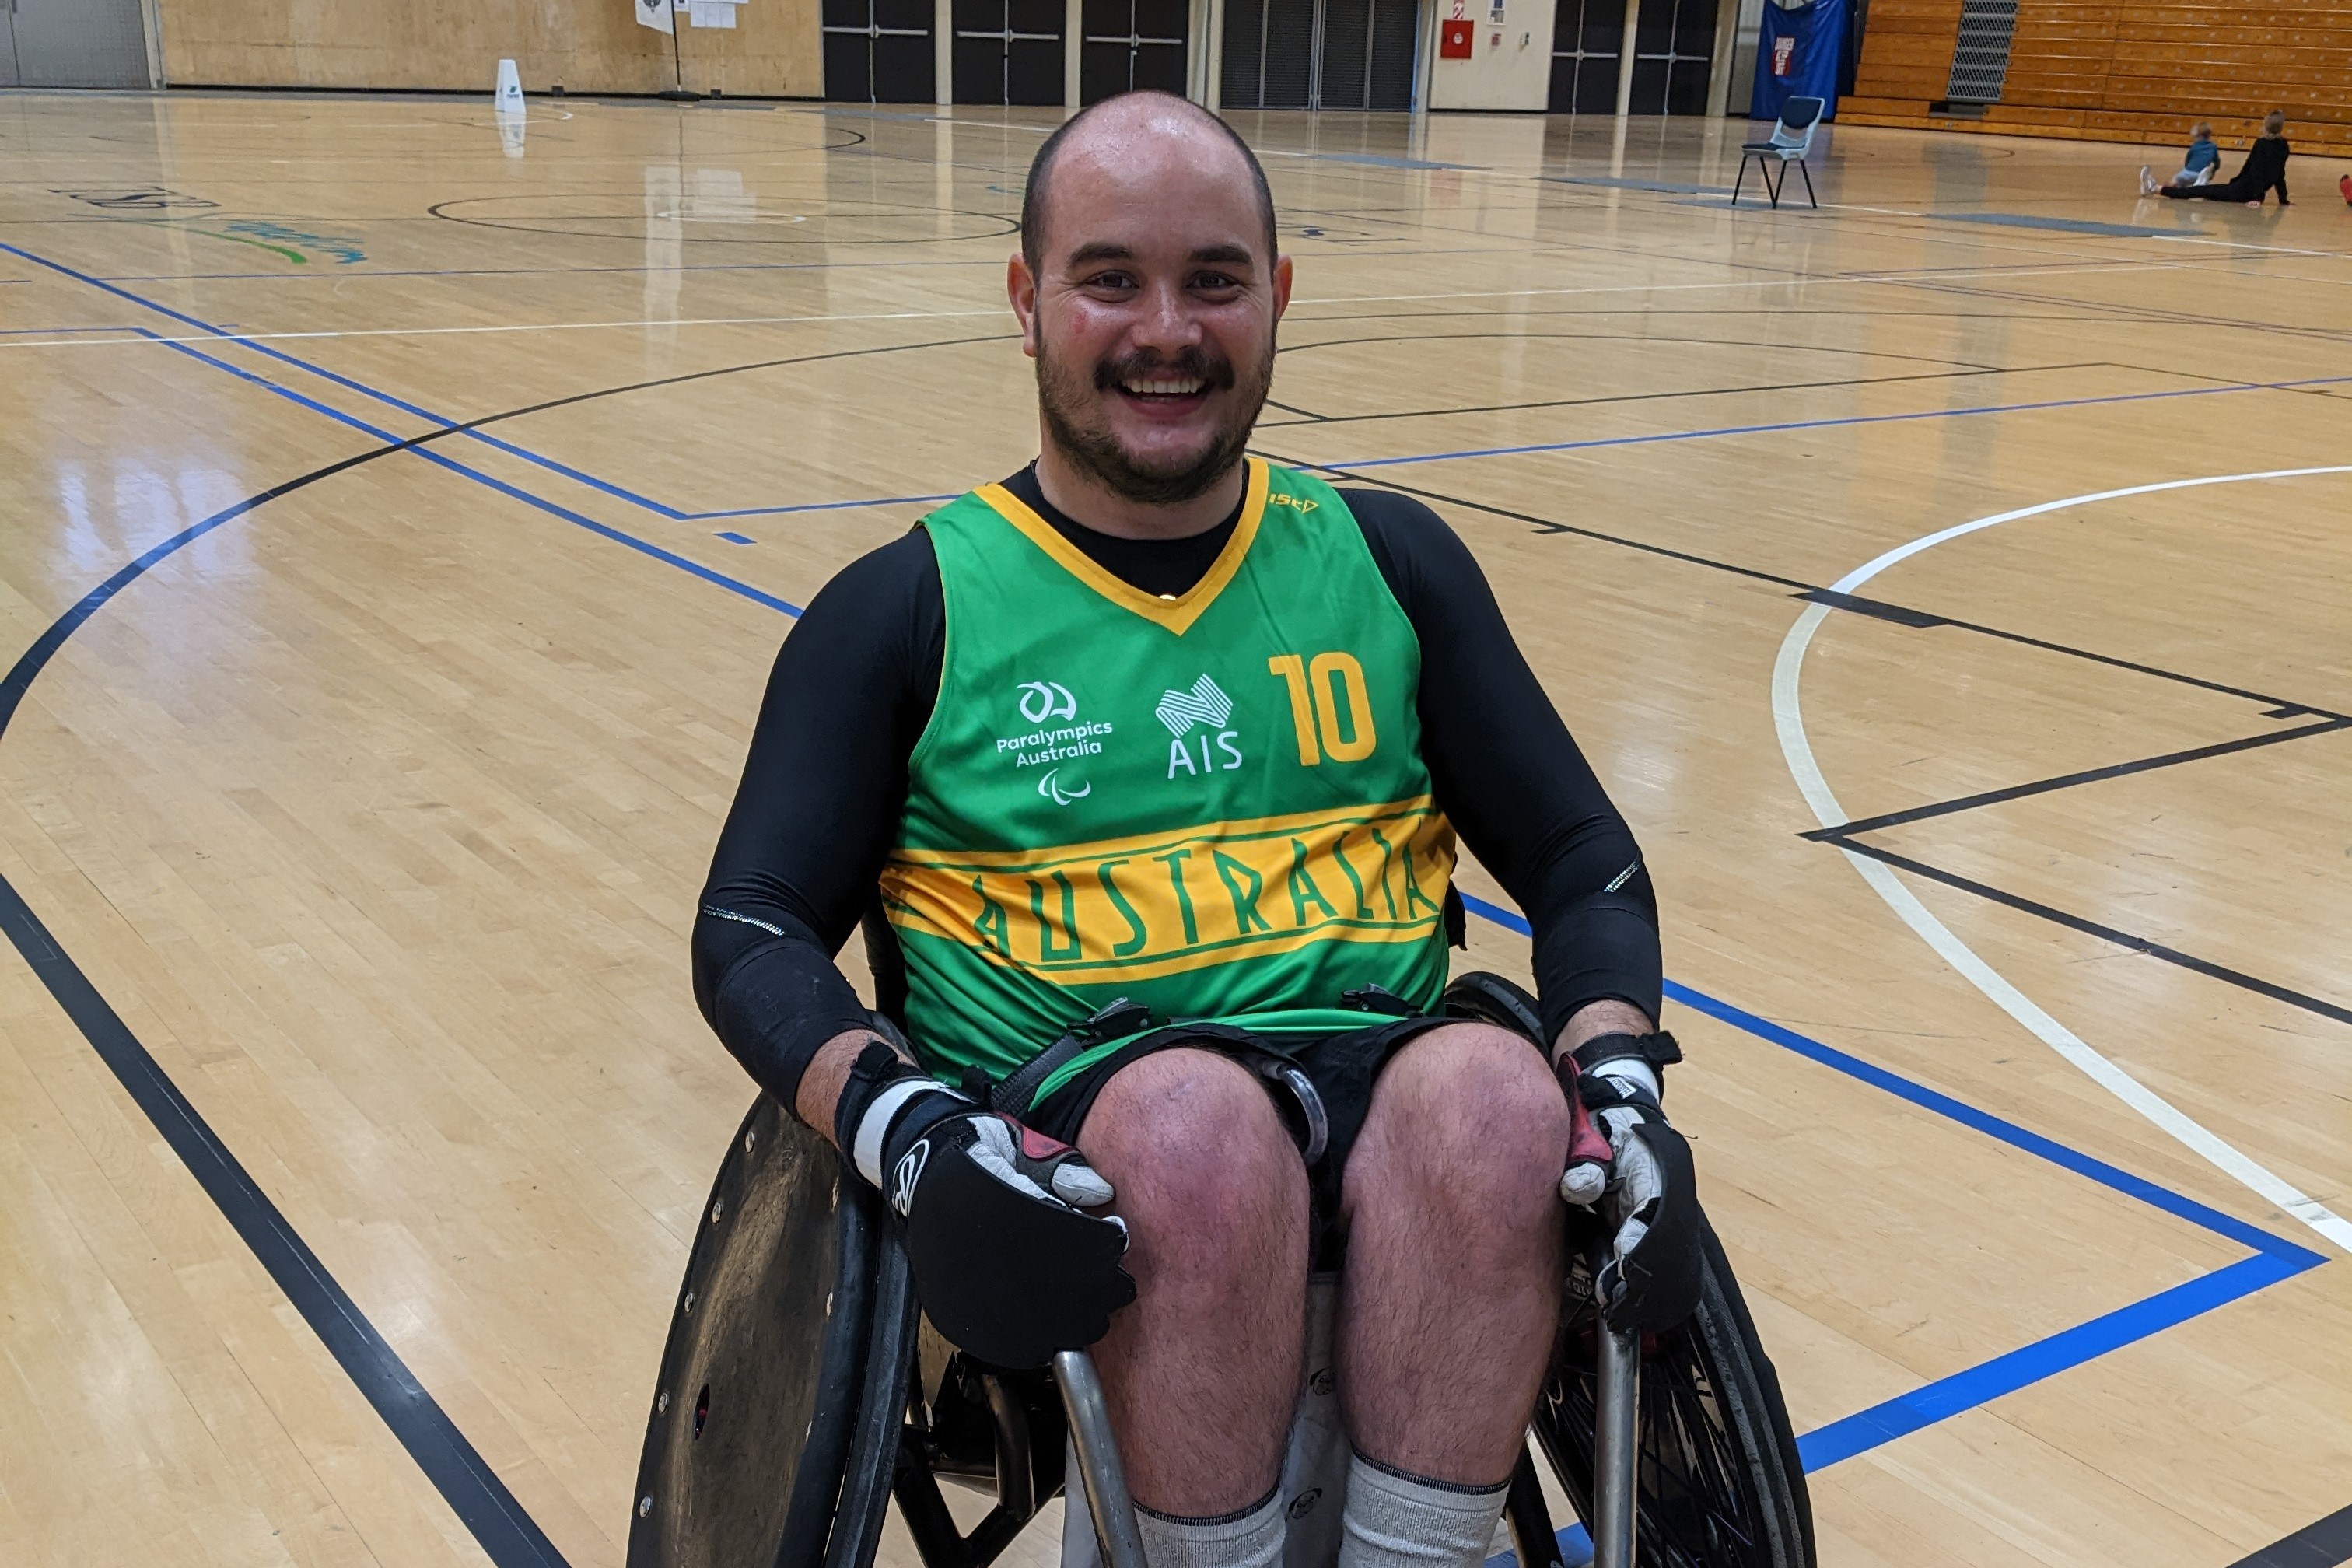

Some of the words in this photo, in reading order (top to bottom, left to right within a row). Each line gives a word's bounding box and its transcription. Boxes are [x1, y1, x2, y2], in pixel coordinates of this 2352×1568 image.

[1268, 651, 1377, 766] 10
[996, 721, 1113, 753] Paralympics
[1016, 740, 1102, 768] Australia
[1167, 731, 1242, 779] AIS
[972, 817, 1439, 962] AUSTRALIA
